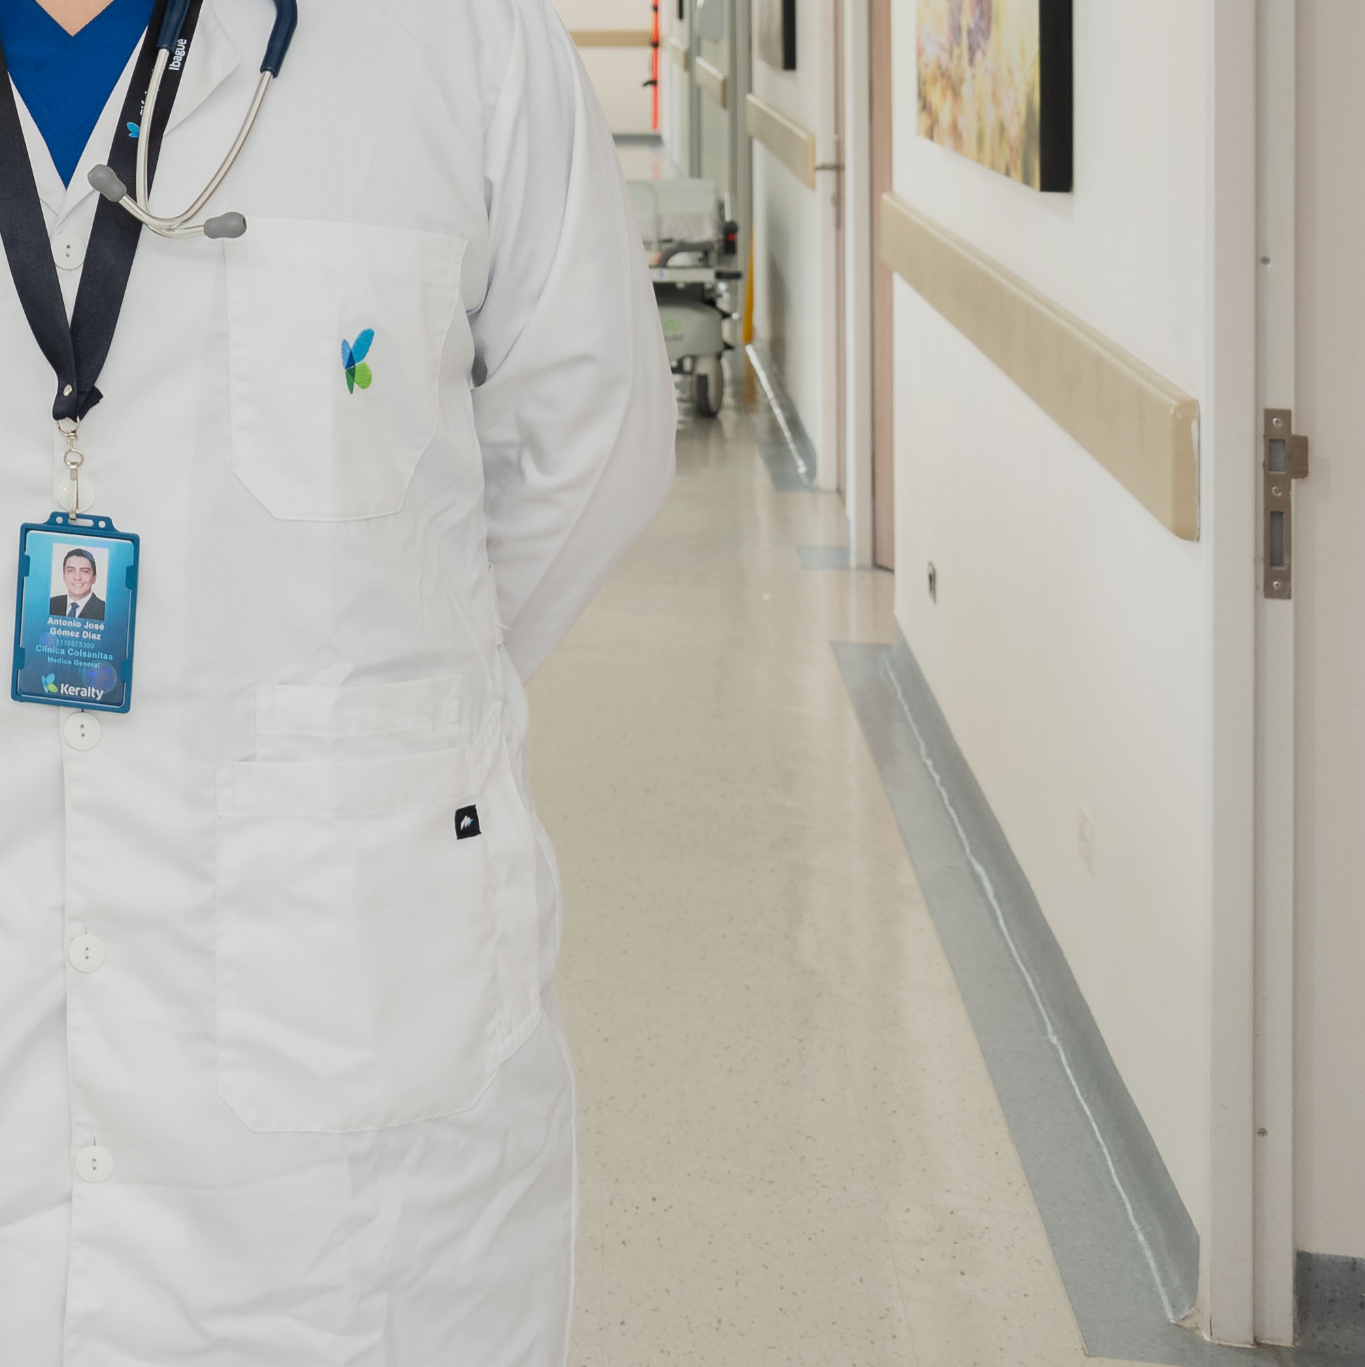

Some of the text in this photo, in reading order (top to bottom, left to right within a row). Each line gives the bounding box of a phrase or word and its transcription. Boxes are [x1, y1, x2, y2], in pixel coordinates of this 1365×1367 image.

[47, 617, 105, 630] Antonio José
[50, 627, 80, 638] Gómez
[67, 648, 114, 660] Colsanitas
[73, 659, 101, 668] General
[60, 683, 104, 701] Keralty
